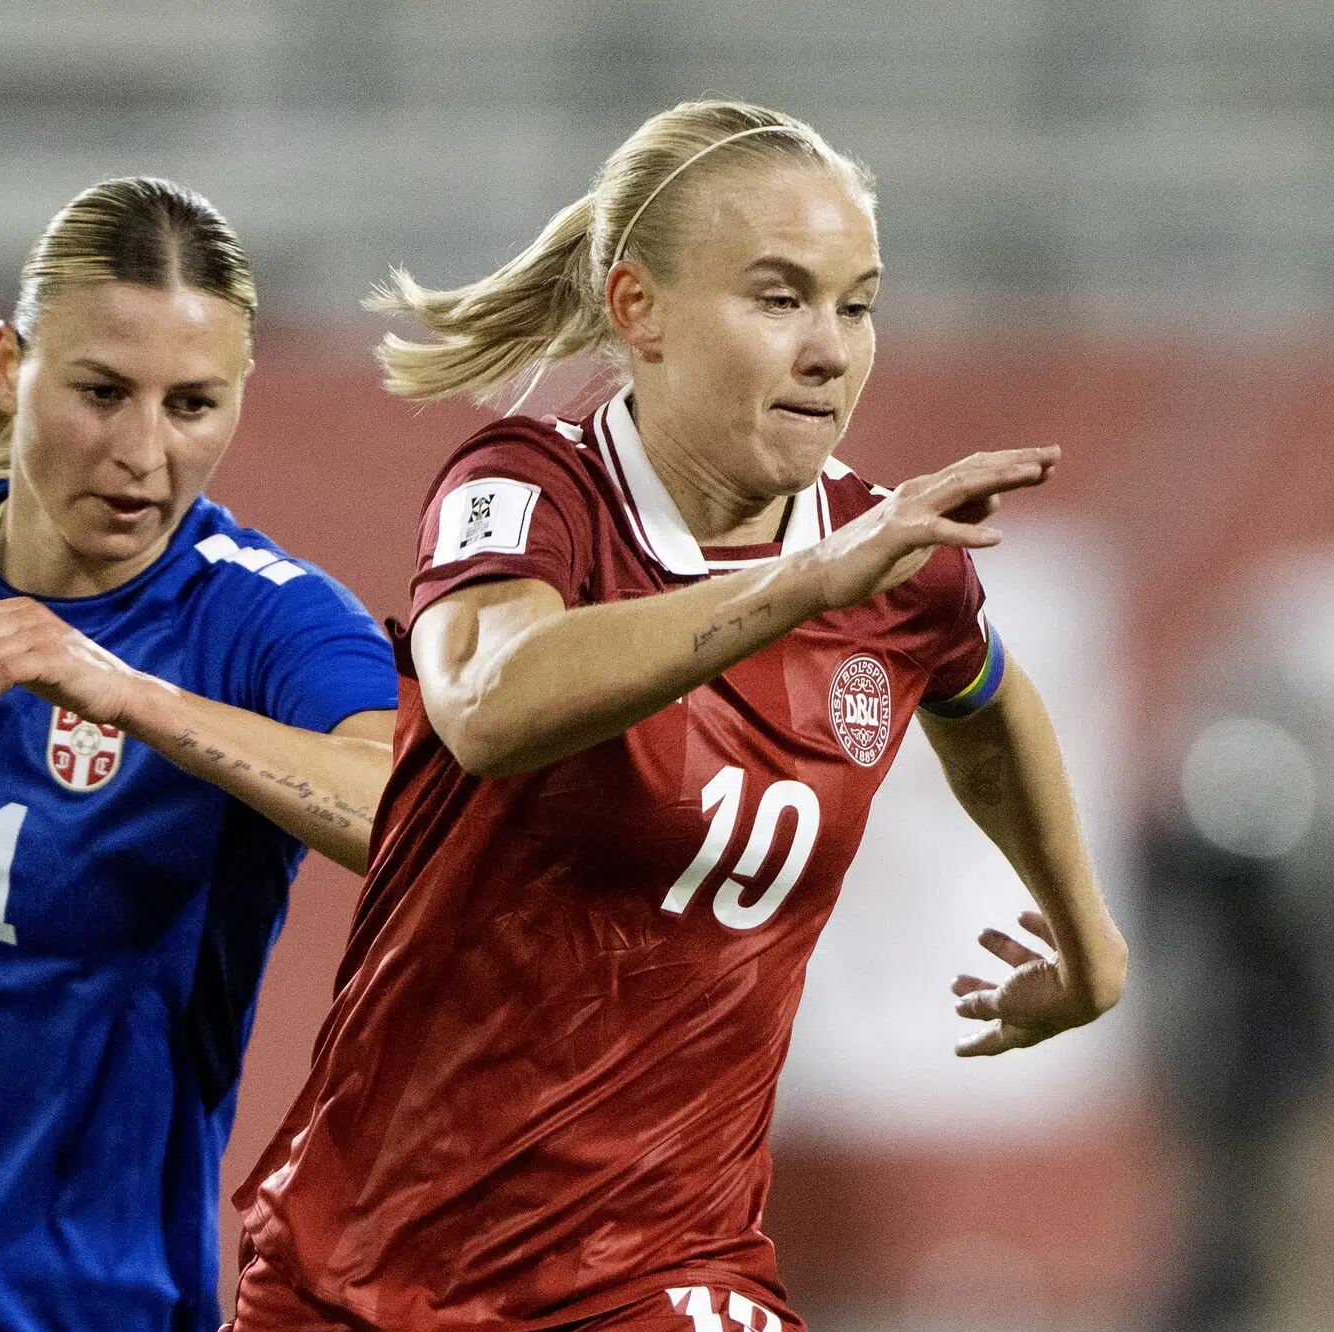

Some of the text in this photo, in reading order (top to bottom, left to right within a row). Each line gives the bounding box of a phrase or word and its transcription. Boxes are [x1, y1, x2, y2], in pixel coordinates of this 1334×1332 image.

[833, 686, 852, 749] DANSK
[854, 748, 876, 763] 1889
[845, 693, 879, 727] DBU
[660, 765, 820, 930] 10
